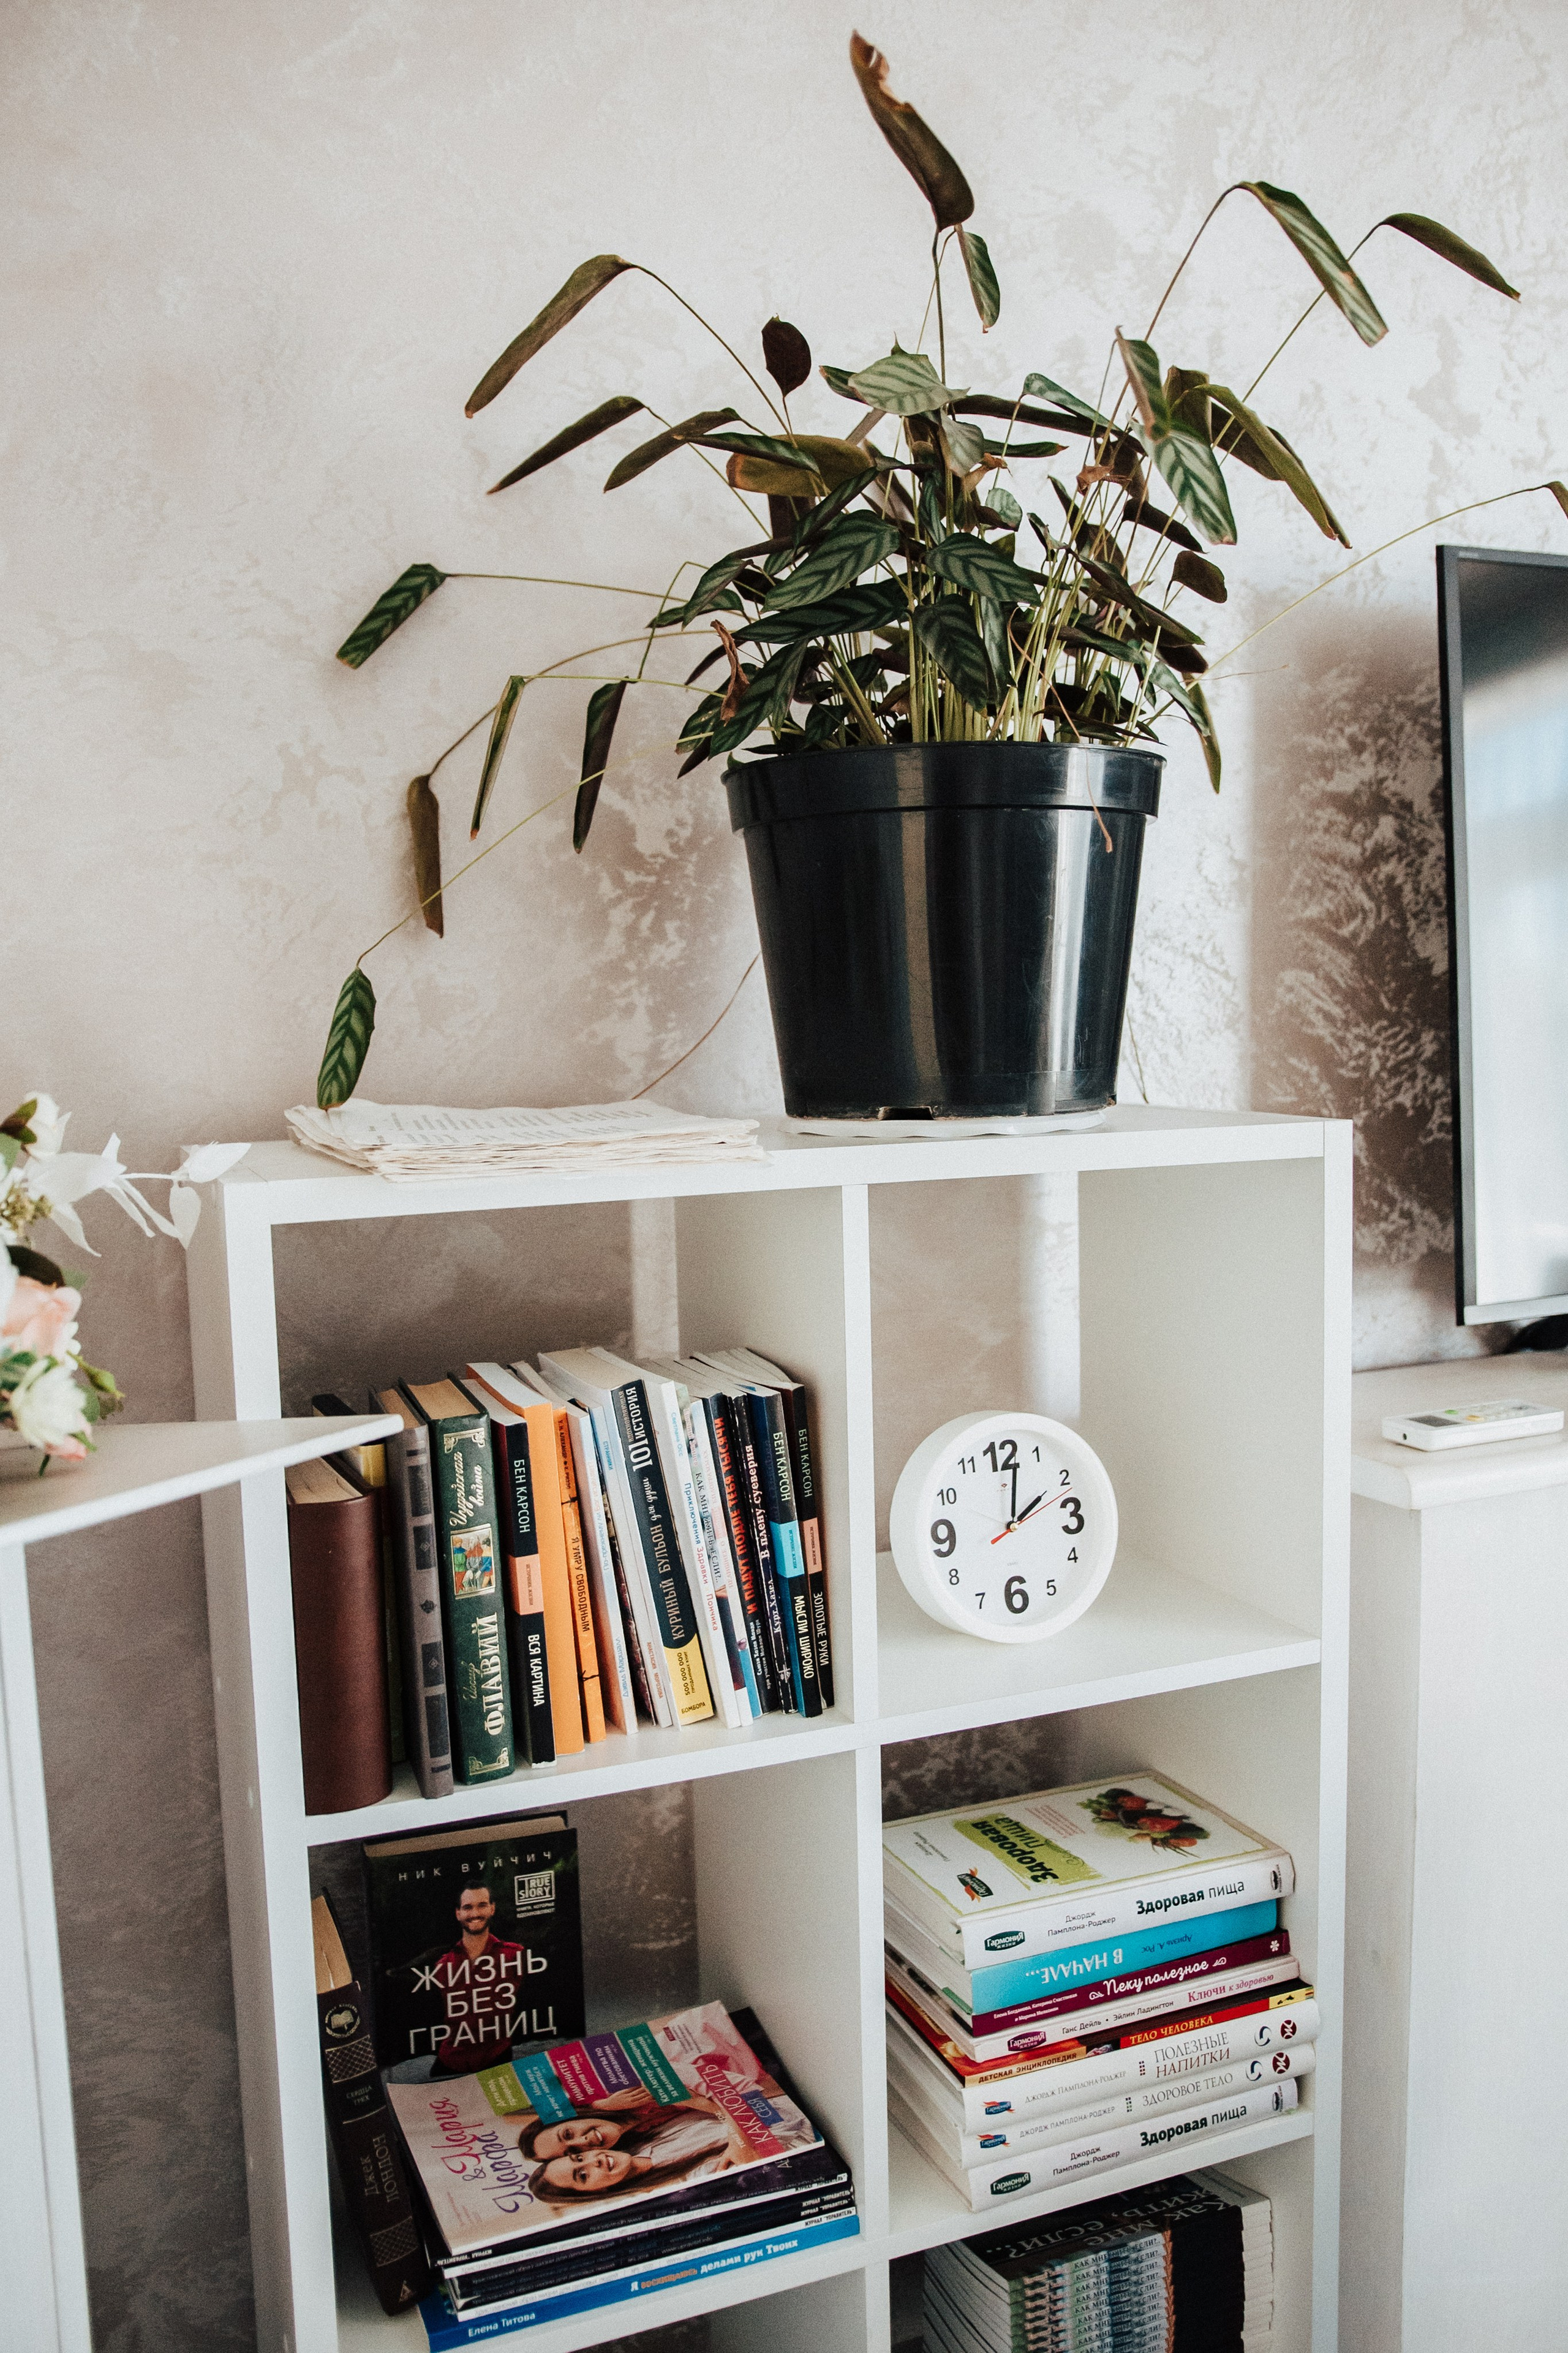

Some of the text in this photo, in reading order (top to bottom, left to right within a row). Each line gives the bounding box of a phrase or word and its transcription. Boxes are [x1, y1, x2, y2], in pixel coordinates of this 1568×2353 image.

[619, 1390, 634, 1443] ВДОХНОВЛЯЮЩАЯ
[625, 1386, 646, 1441] ИСТОРИЯ
[671, 1411, 680, 1441] Светлана
[603, 1441, 613, 1470] СТРАННИКИ
[628, 1438, 653, 1472] 101
[773, 1432, 791, 1501] БЕН КАРСОН
[798, 1429, 813, 1497] БЕН КАРСОН
[958, 1456, 976, 1474] 11
[983, 1440, 1020, 1472] 12
[1032, 1446, 1041, 1462] 1
[450, 1451, 473, 1527] Иудейская
[470, 1464, 484, 1506] война
[695, 1472, 704, 1492] КАК
[1059, 1469, 1071, 1486] 2
[513, 1459, 530, 1533] БЕН КАРСОН
[699, 1494, 709, 1515] МНЕ
[745, 1445, 770, 1558] В плену суеверия
[937, 1487, 957, 1505] 10
[714, 1418, 758, 1614] И ПАДУТ ПОДЛЕ ТЕБЯ ТЫСЯЧИ
[1060, 1497, 1084, 1535] 3
[650, 1524, 671, 1576] БУЛЬОН
[930, 1519, 956, 1557] 9
[1067, 1547, 1078, 1563] 4
[572, 1544, 582, 1571] УМРУ
[684, 1482, 717, 1631] Приключения Здравки Пончика
[949, 1569, 960, 1585] 8
[1046, 1579, 1057, 1596] 5
[574, 1573, 590, 1632] СВОБОДНЫМ
[659, 1577, 685, 1641] КУРИНЫЙ
[767, 1579, 781, 1633] Курт Хазел
[975, 1592, 986, 1609] 7
[1005, 1576, 1029, 1614] 6
[794, 1595, 815, 1679] МЫСЛИ ШИРОКО
[813, 1592, 829, 1666] ЗОЛОТЫЕ РУКИ
[527, 1634, 545, 1707] ВСЯ КАРТИНА
[616, 1637, 625, 1673] Маршалл
[646, 1642, 663, 1699] АНАСТАСИЯ МОРОЗОВА
[472, 1612, 505, 1735] ФЛАВИЙ
[686, 1664, 695, 1693] ПРОДАННЫХ
[681, 1701, 706, 1714] БОМБОРА
[995, 1817, 1045, 1848] пища
[399, 1851, 552, 1881] НИК ВУЙЧИЧ
[971, 1820, 1059, 1883] Здоровая
[518, 1876, 551, 1890] TRUE
[519, 1886, 552, 1899] STORY
[1136, 1881, 1245, 1915] Здоровая пища
[1047, 1917, 1116, 1937] Памплона-Роджер
[1065, 1911, 1096, 1923] Джордж
[1142, 1934, 1193, 1954] Ариэль Рос
[410, 1949, 548, 1993] ЖИЗНЬ
[1025, 1948, 1123, 1984] В НАЧАЛЕ...
[1103, 1960, 1209, 1995] Пеку полезное
[447, 1982, 516, 2018] БЕЗ
[1188, 1986, 1226, 2003] Ключи
[1235, 1974, 1274, 1991] здоровью
[409, 2006, 557, 2055] ГРАНИЦ
[1061, 2001, 1174, 2035] Ганс Дейль Эйлин Ладингтон
[1130, 2015, 1213, 2045] ТЕЛО ЧЕЛОВЕКА
[628, 2039, 647, 2068] женщина
[1155, 2032, 1229, 2063] ПОЛЕЗНЫЕ
[1156, 2047, 1231, 2078] НАПИТКИ
[556, 2060, 585, 2101] ИММУНИТЕТ
[570, 2055, 595, 2095] против гнева
[595, 2047, 619, 2085] Молитва по
[604, 2045, 629, 2085] обетованиям
[656, 2068, 673, 2091] великим
[978, 2053, 1077, 2083] ДЕТСКАЯ ЭНЦИКЛОПЕДИЯ
[656, 2088, 670, 2103] Кати
[701, 2064, 774, 2144] КАК ЛЮБИТЬ
[1142, 2072, 1233, 2107] ЗДОРОВОЕ ТЕЛО
[748, 2098, 772, 2118] СЕБЯ
[429, 2096, 484, 2175] Мария
[1020, 2124, 1049, 2138] ДЖОРДЖ
[1140, 2105, 1247, 2147] Здоровая пища
[373, 2133, 400, 2202] ЛОНДОН
[1053, 2150, 1120, 2175] Памплона-Роджер
[1070, 2146, 1101, 2161] Джордж
[360, 2156, 379, 2196] Джек
[462, 2167, 486, 2181] &
[476, 2130, 534, 2213] Марфа
[801, 2206, 819, 2216] ЖУРНАЛ
[804, 2216, 822, 2227] ЖУРНАЛ
[1082, 2202, 1228, 2246] Как мне
[630, 2239, 798, 2292] Я восхищаюсь делами рук Твоих
[1074, 2253, 1109, 2269] КАК МНЕ
[468, 2313, 536, 2338] Елена Титова
